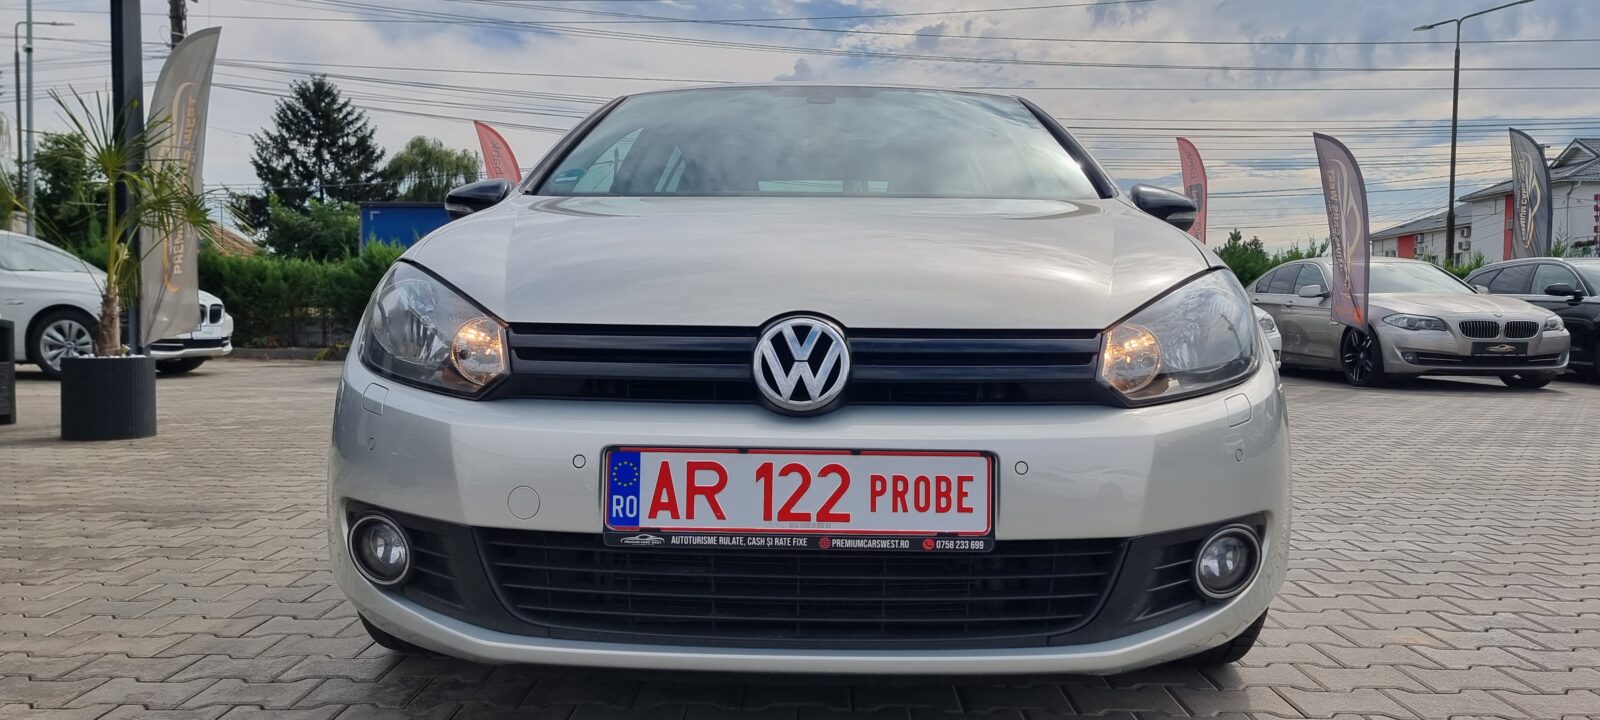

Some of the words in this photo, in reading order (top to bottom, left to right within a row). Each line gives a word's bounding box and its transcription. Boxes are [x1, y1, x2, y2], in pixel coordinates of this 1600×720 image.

[647, 460, 729, 520] AR
[755, 462, 852, 523] 122
[869, 474, 974, 514] PROBE
[612, 495, 638, 518] RO
[671, 535, 718, 545] AUTOTURISME
[719, 536, 746, 546] RULATE,
[747, 537, 765, 546] CASH
[774, 538, 792, 547] RATE
[792, 538, 808, 547] FIXE
[831, 539, 910, 549] PREMIUMCARSWEST.RO
[936, 540, 954, 549] 0758
[955, 541, 969, 549] 233
[970, 541, 984, 550] 699
